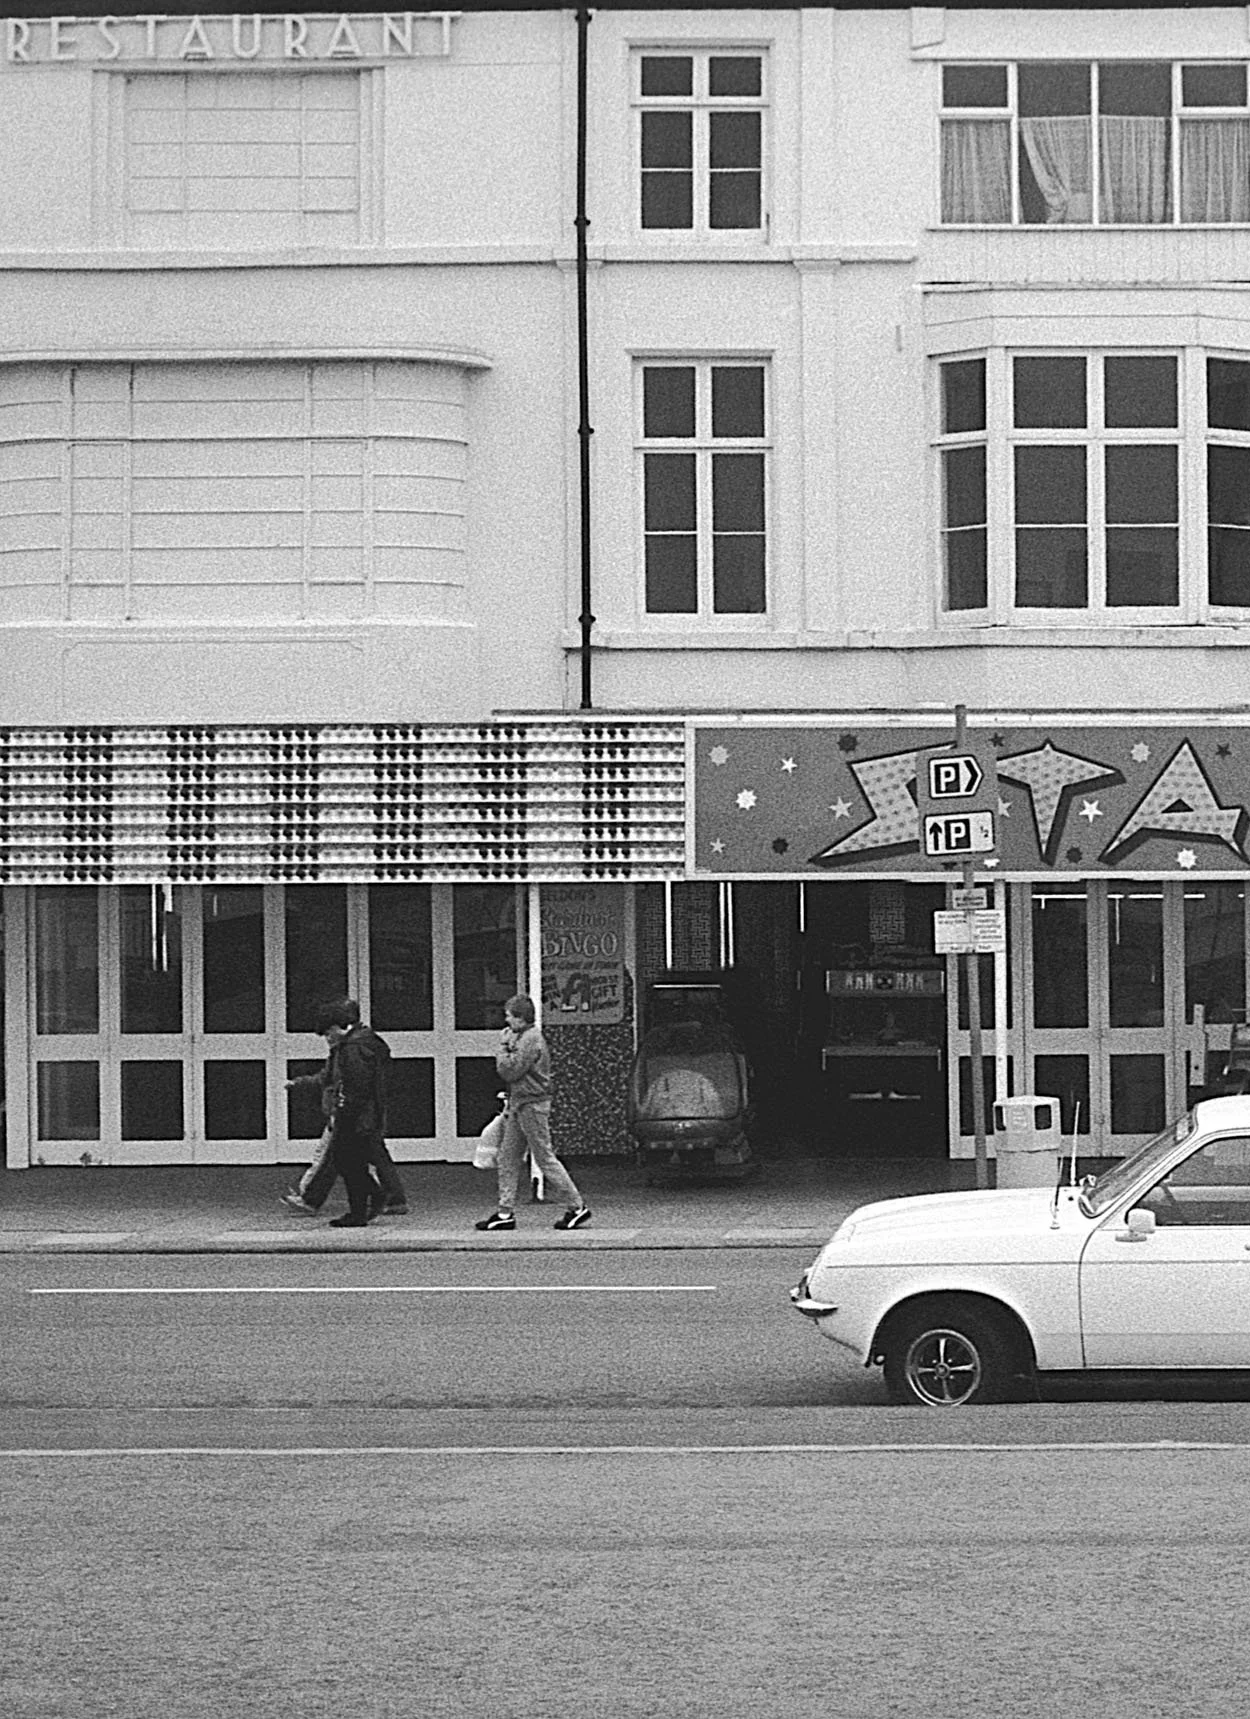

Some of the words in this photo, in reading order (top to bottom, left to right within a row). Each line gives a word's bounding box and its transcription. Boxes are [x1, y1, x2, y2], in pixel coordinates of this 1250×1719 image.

[7, 11, 462, 61] RESTAURANT
[939, 766, 956, 792] P
[950, 821, 966, 848] P
[541, 931, 618, 957] BINGO
